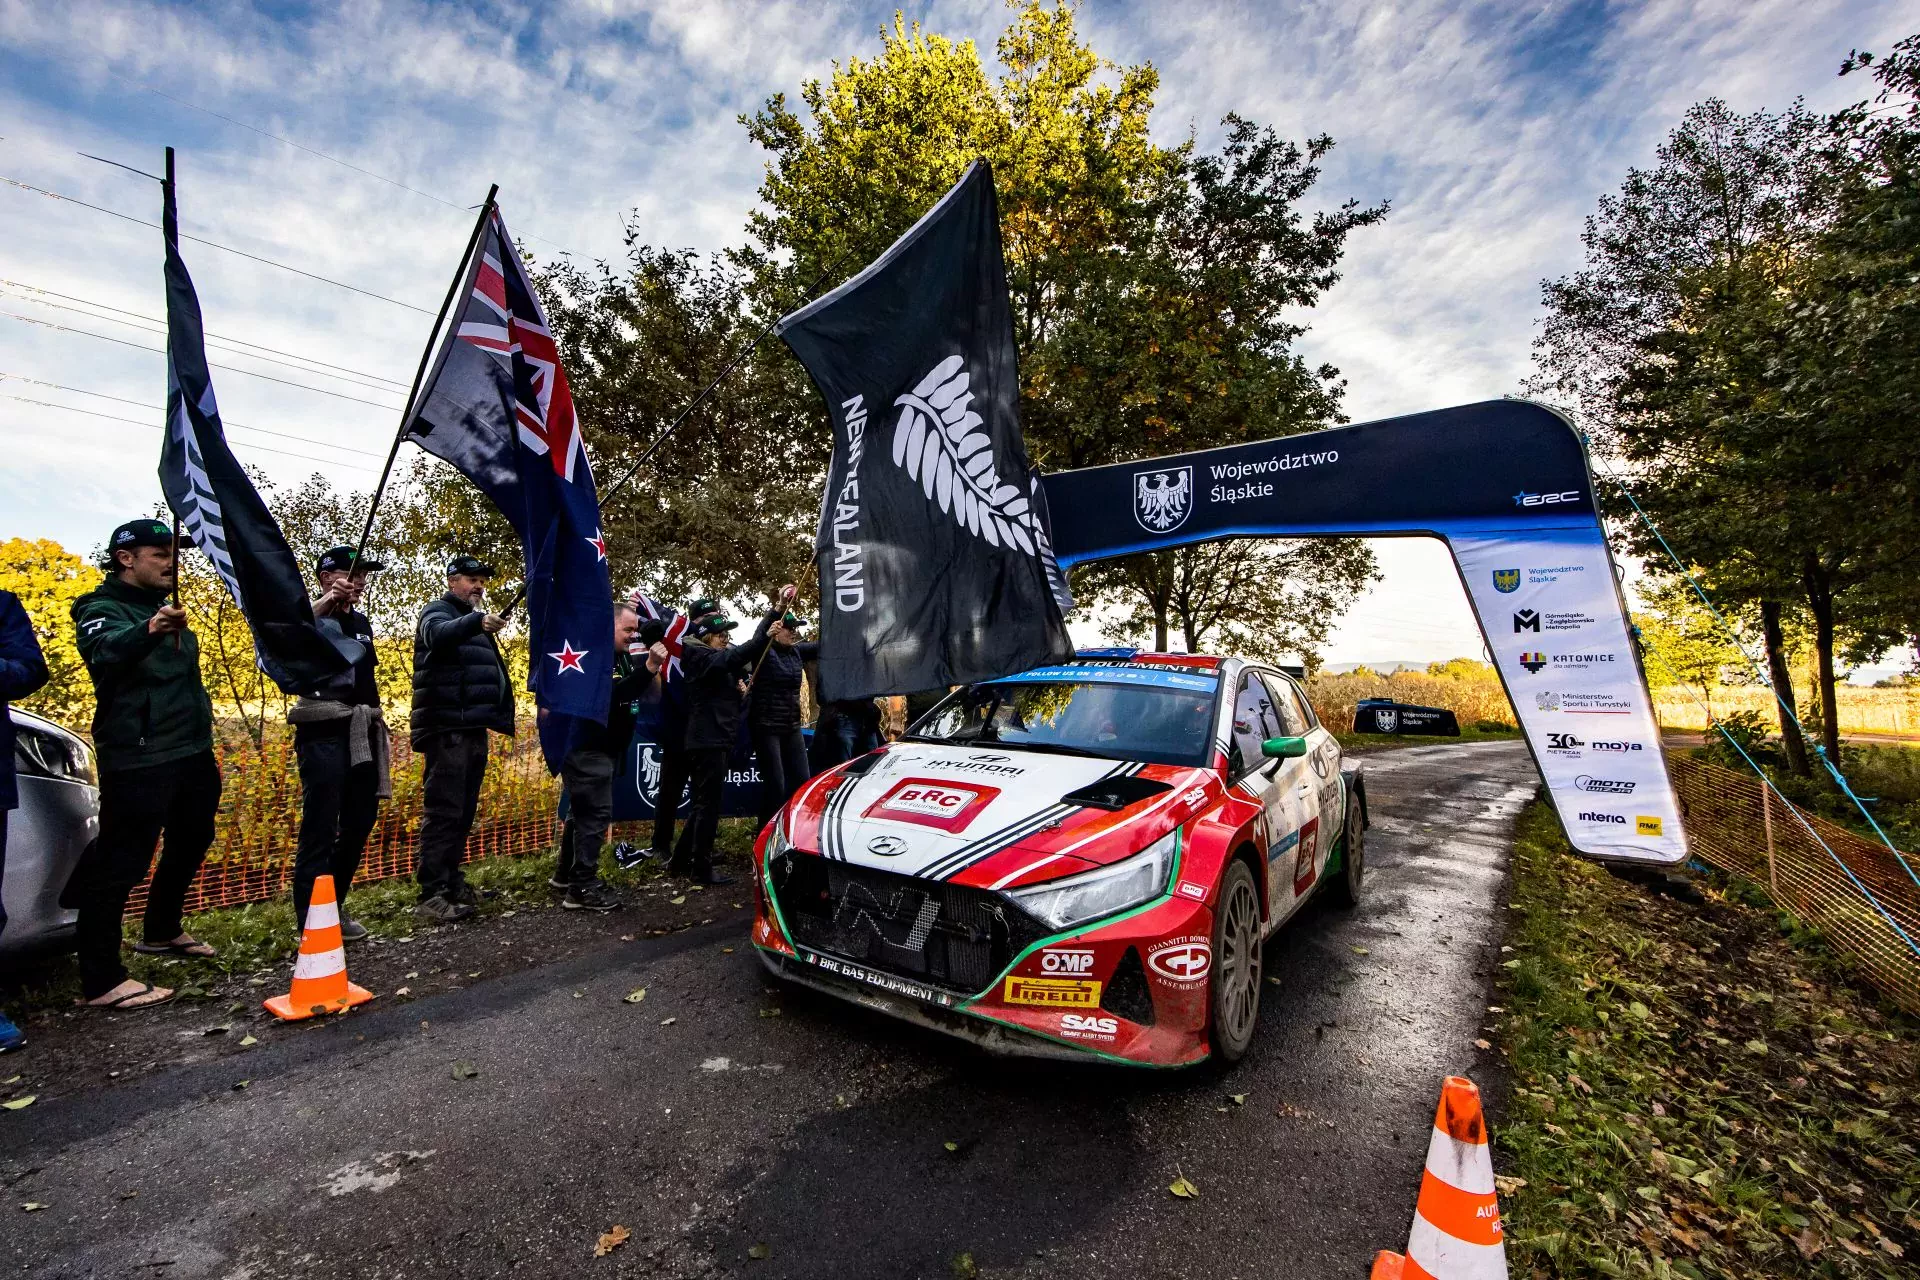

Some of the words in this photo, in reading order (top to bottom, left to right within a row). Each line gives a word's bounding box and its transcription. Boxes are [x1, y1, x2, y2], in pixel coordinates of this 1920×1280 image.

[842, 394, 868, 464] NEW
[1210, 450, 1339, 480] Województwo
[1210, 482, 1274, 504] Śląskie
[1523, 491, 1580, 506] ERC
[1528, 565, 1584, 575] Województwo
[1553, 654, 1615, 662] KATOWICE
[1084, 661, 1191, 672] EQUIPMENT
[1562, 700, 1588, 708] Sportu
[1402, 711, 1440, 719] Województwo
[1592, 741, 1642, 753] moya
[928, 760, 1025, 774] HYUNDAI
[1588, 780, 1636, 788] MOTO
[899, 790, 961, 807] BRC
[1579, 812, 1626, 824] interia
[1148, 936, 1187, 953] GIANNITTI
[1041, 954, 1094, 972] OMP
[819, 957, 839, 973] BRC
[842, 964, 864, 980] GAS
[866, 972, 934, 1001] EQUIPMENT
[1011, 983, 1093, 1002] PIRELLI
[1060, 1014, 1118, 1034] SAS
